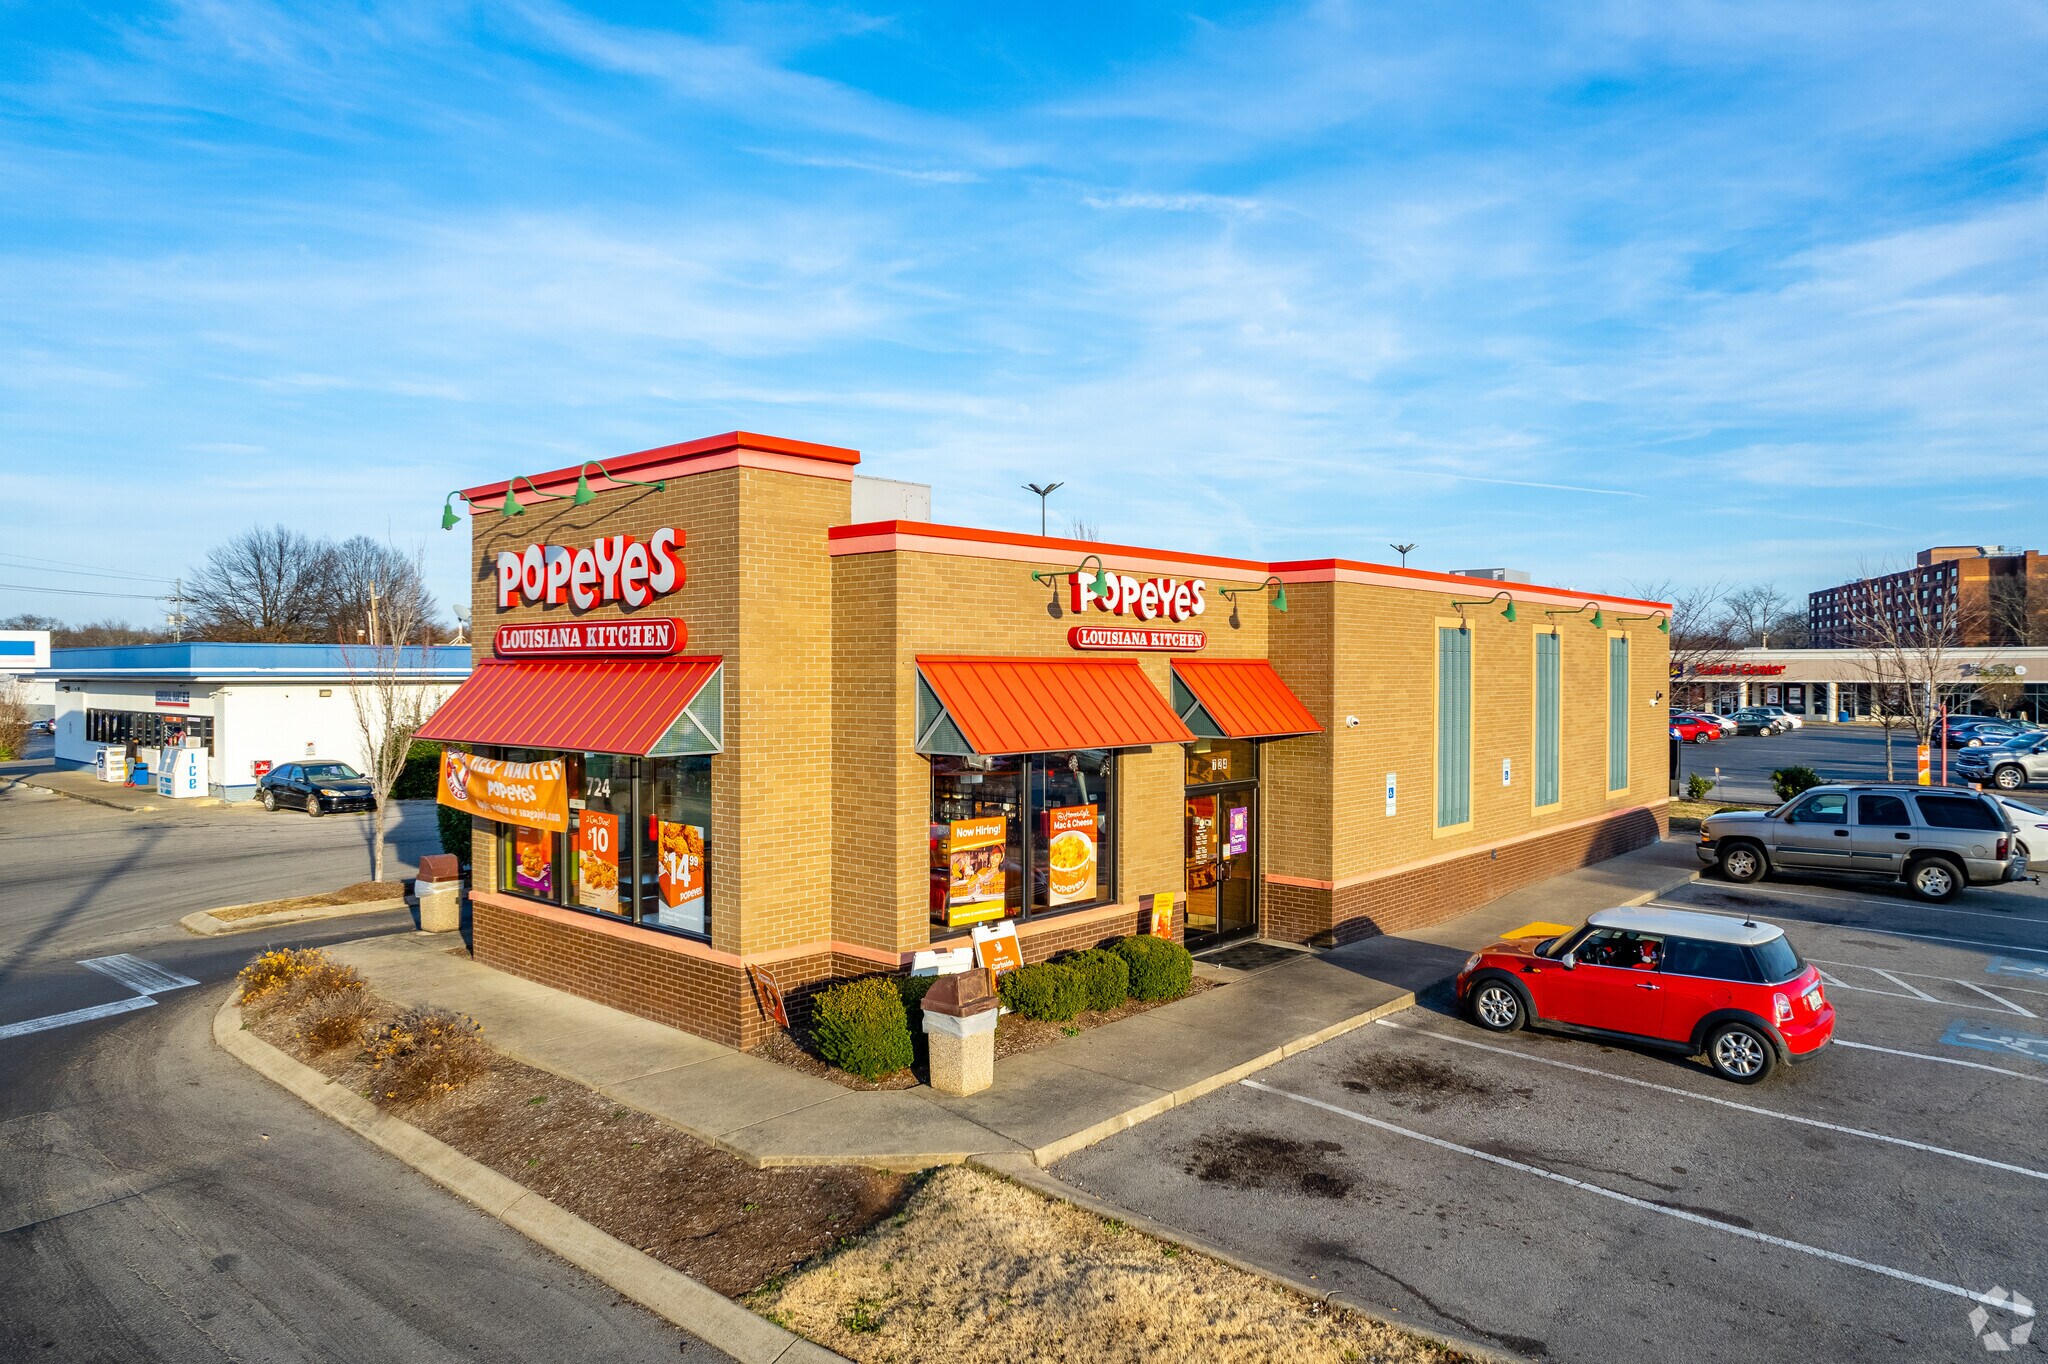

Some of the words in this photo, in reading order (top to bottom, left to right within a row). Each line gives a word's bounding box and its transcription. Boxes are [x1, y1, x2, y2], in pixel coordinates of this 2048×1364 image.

[501, 627, 581, 649] LOUISIANA
[586, 625, 670, 647] KITCHEN
[1082, 630, 1148, 646] LOUISIANA
[1150, 632, 1202, 647] KITCHEN
[586, 777, 610, 798] 724
[510, 808, 518, 816] or
[956, 828, 974, 838] Now
[975, 824, 1001, 836] Hiring!
[1053, 821, 1067, 830] Mac
[1067, 820, 1072, 828] &
[1072, 819, 1093, 829] Cheese
[587, 826, 609, 853] $10
[991, 959, 1015, 971] Curbside
